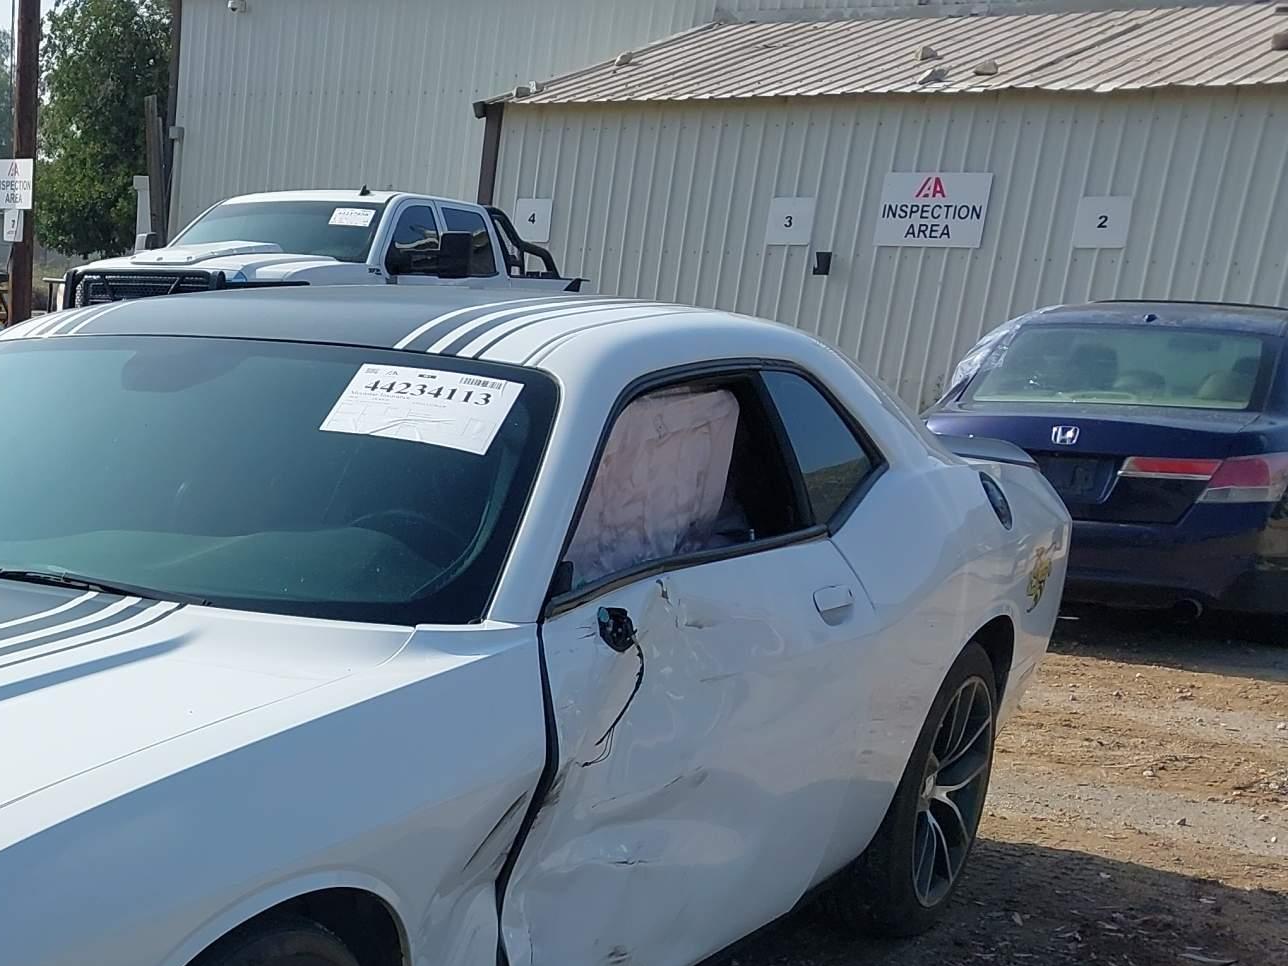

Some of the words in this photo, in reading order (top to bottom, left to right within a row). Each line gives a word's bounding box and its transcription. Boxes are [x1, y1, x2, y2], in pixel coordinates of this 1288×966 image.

[5, 193, 22, 203] AREA
[527, 212, 537, 225] 4
[881, 204, 983, 220] INSPECTION
[783, 215, 793, 228] 3
[1096, 215, 1109, 229] 2
[903, 223, 951, 240] AREA
[364, 380, 491, 405] 44234113
